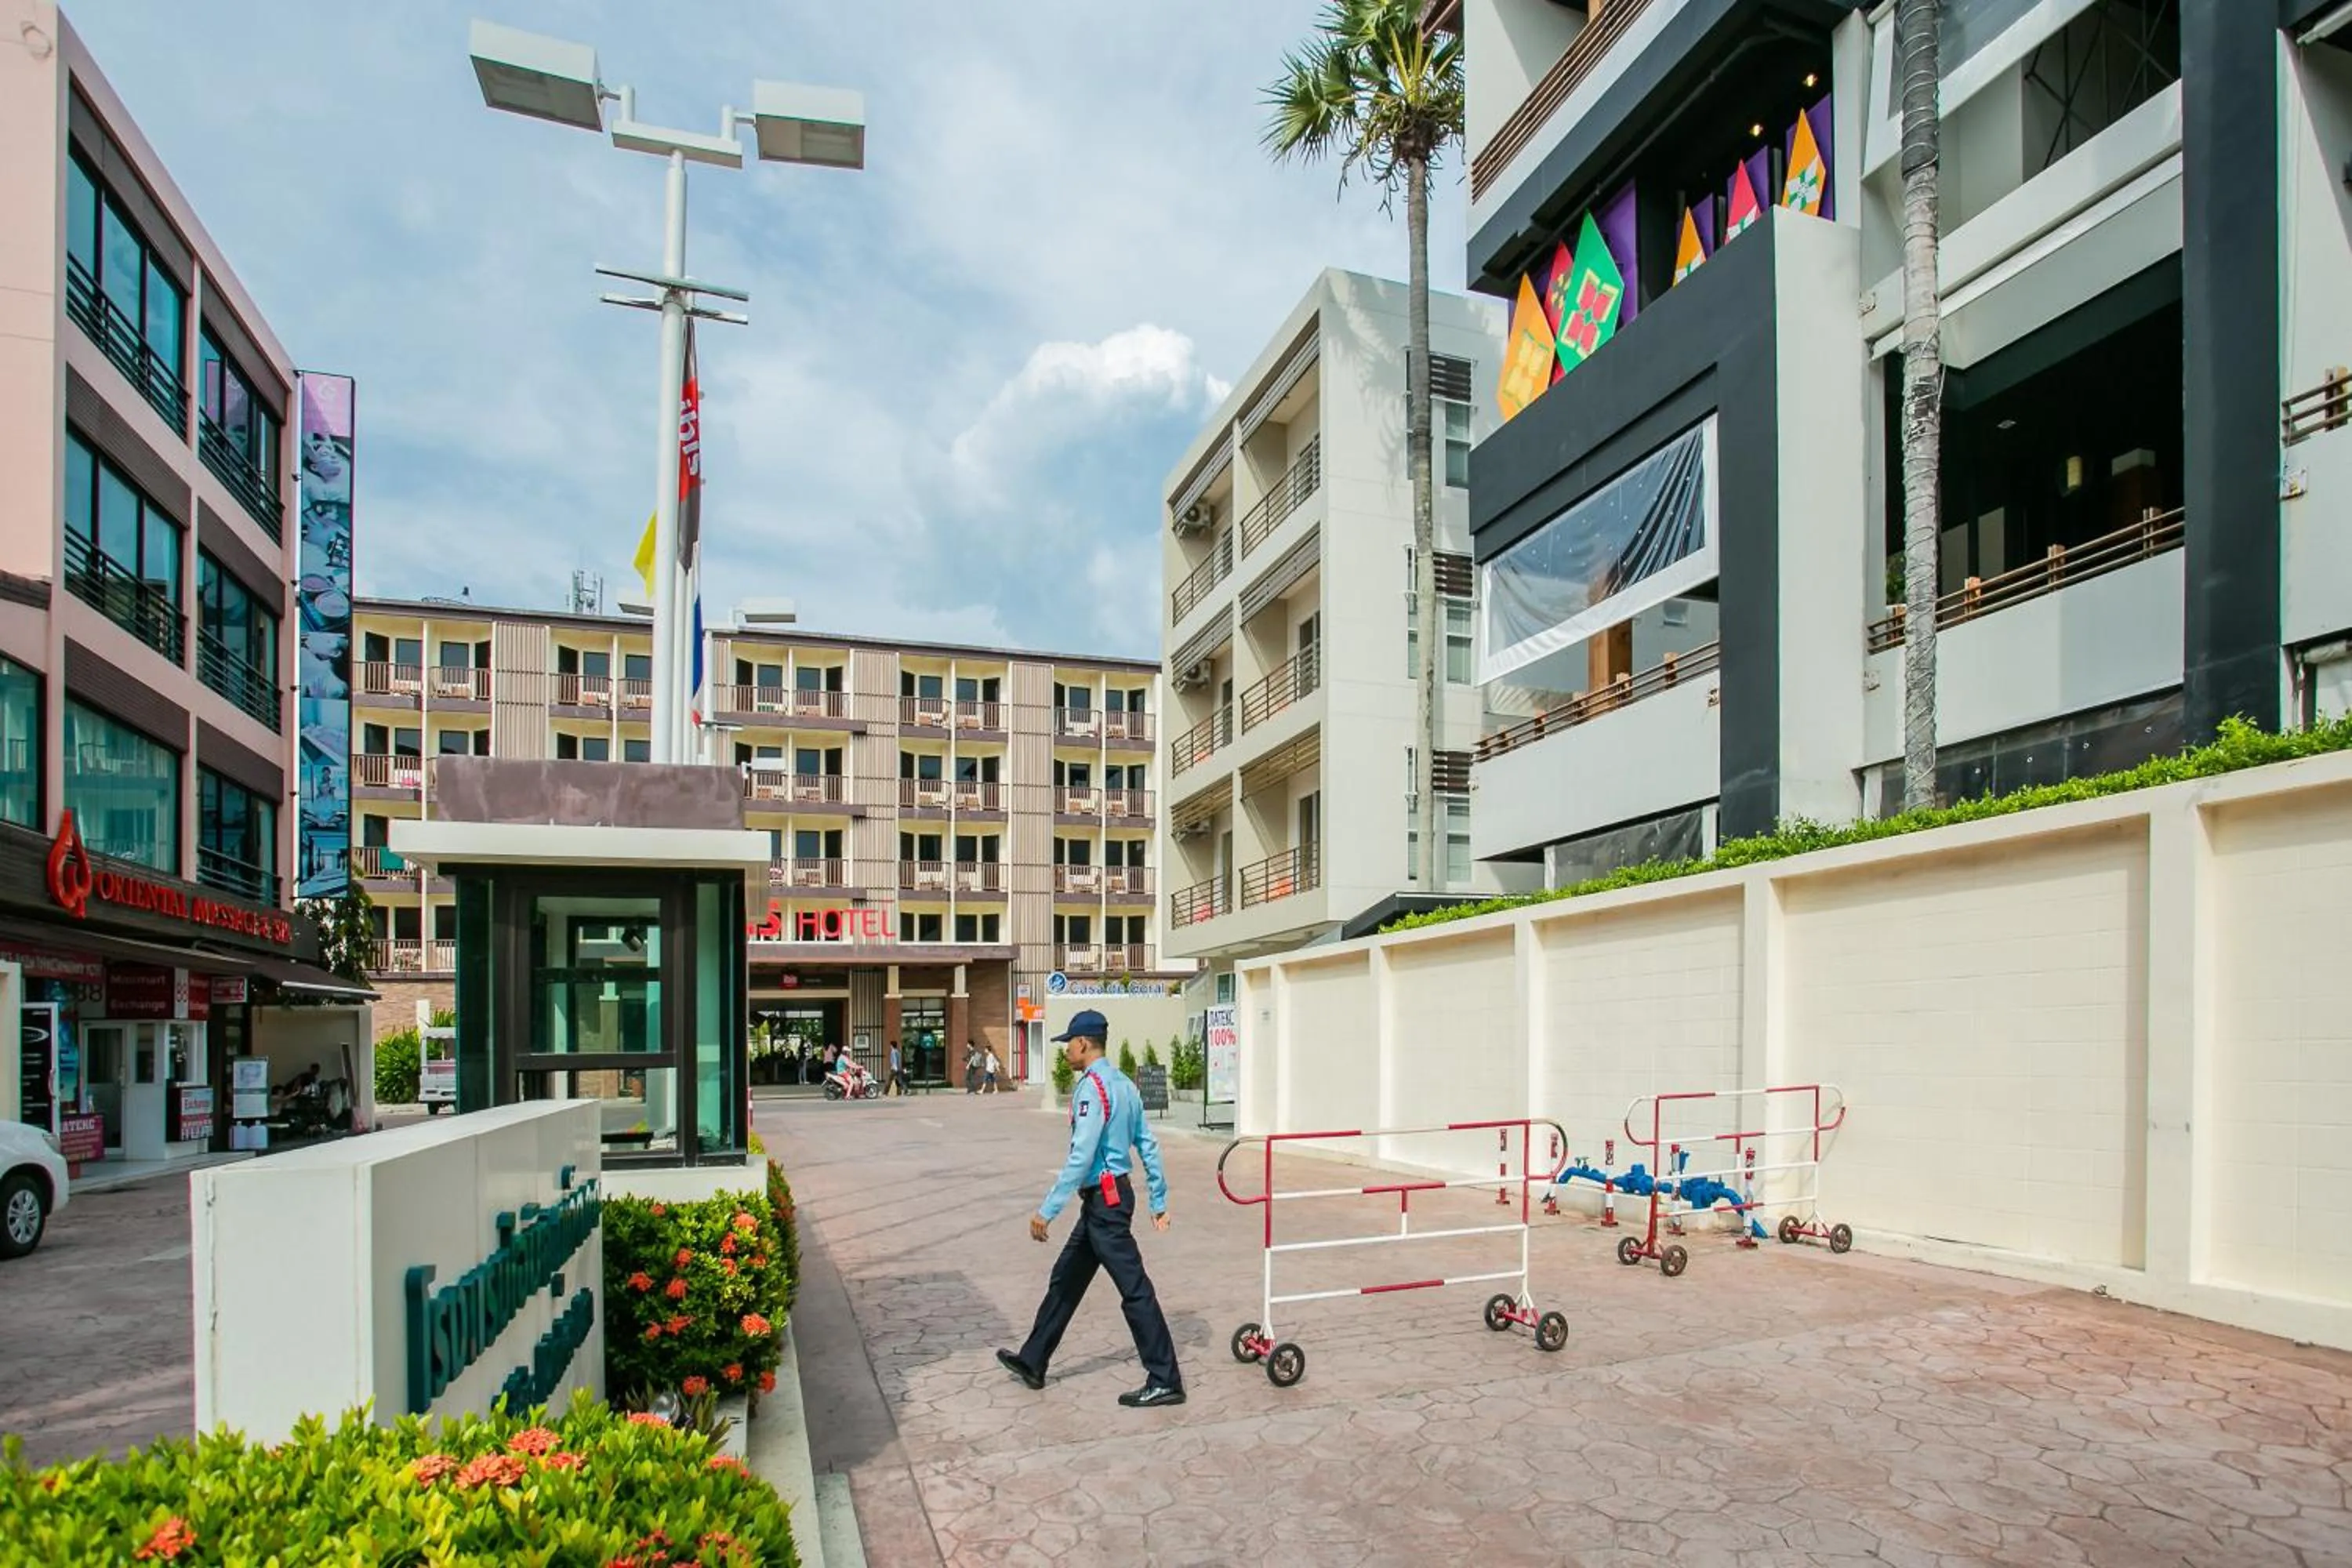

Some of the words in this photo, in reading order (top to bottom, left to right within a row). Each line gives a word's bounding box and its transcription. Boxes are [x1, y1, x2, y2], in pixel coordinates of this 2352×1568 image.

[95, 871, 188, 919] ORIENTAL
[191, 896, 259, 935] MASSAGE
[797, 908, 896, 938] HOTEL
[1069, 981, 1104, 995] Casa
[110, 999, 166, 1012] Exchange
[1210, 1028, 1237, 1047] 100%
